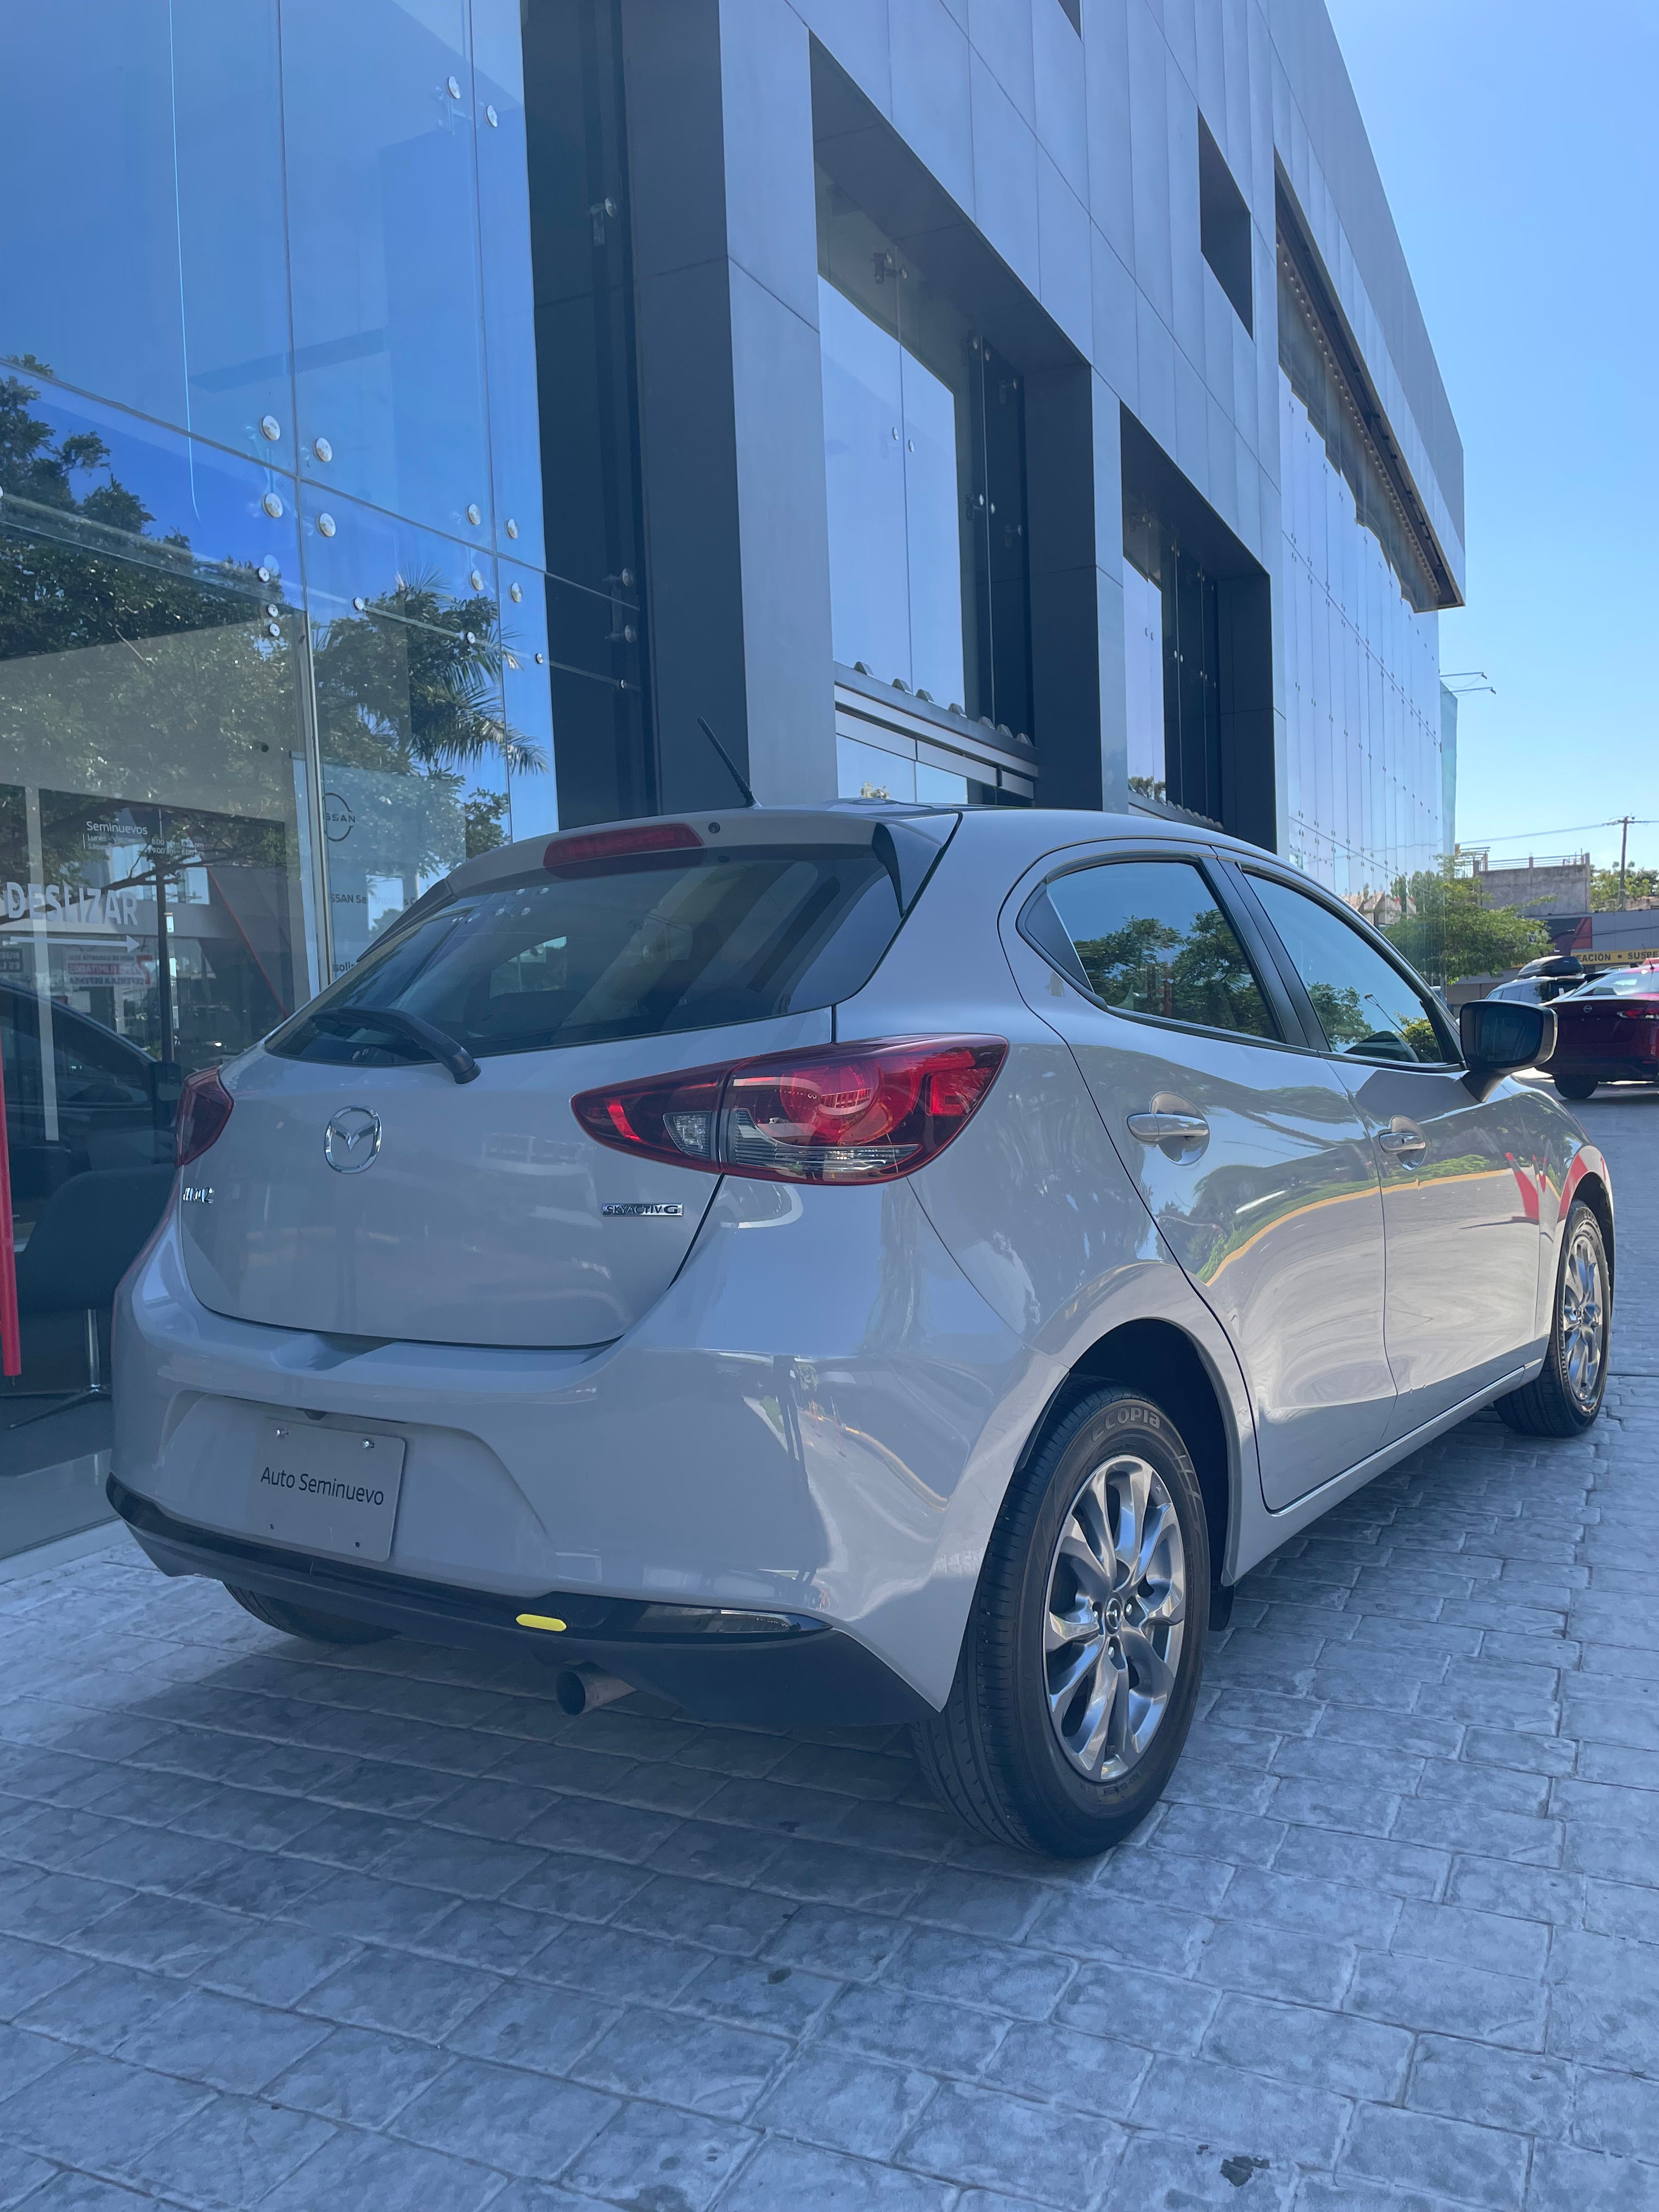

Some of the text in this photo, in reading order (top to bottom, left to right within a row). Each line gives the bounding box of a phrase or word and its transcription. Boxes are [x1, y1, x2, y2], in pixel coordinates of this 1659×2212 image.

[86, 821, 148, 835] Seminuevos
[7, 882, 138, 926] DESLIZAR
[260, 1466, 384, 1506] Auto Seminuevo
